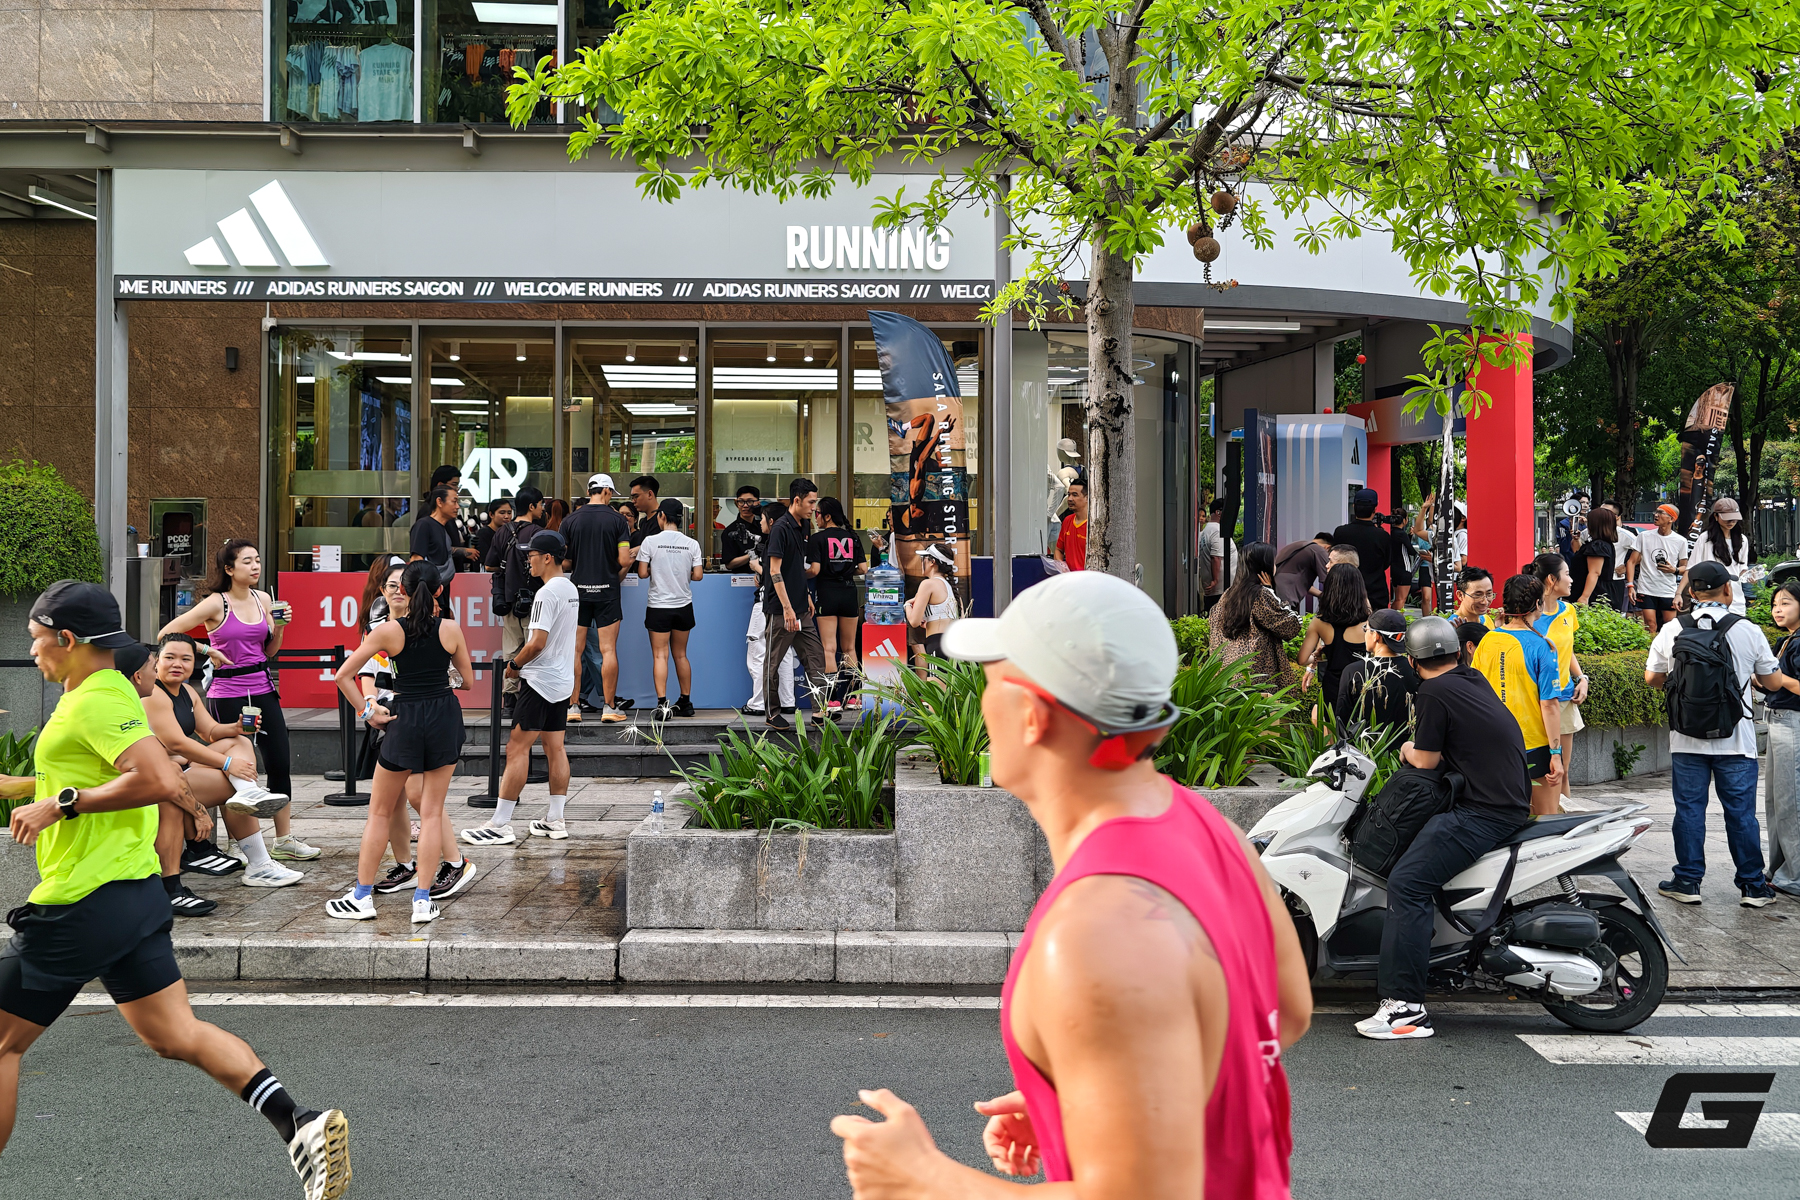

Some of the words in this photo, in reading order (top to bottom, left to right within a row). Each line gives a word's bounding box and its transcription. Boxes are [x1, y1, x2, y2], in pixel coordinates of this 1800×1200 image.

[786, 225, 950, 270] RUNNING
[152, 280, 227, 295] RUNNERS
[266, 281, 325, 295] ADIDAS
[328, 281, 402, 296] RUNNERS
[403, 281, 464, 296] SAIGON
[504, 281, 586, 296] WELCOME
[588, 282, 663, 297] RUNNERS
[703, 283, 761, 297] ADIDAS
[764, 283, 838, 298] RUNNERS
[840, 284, 900, 298] SAIGON
[932, 372, 947, 412] SALA
[938, 421, 954, 496] RUNNING
[1704, 427, 1719, 456] SALA
